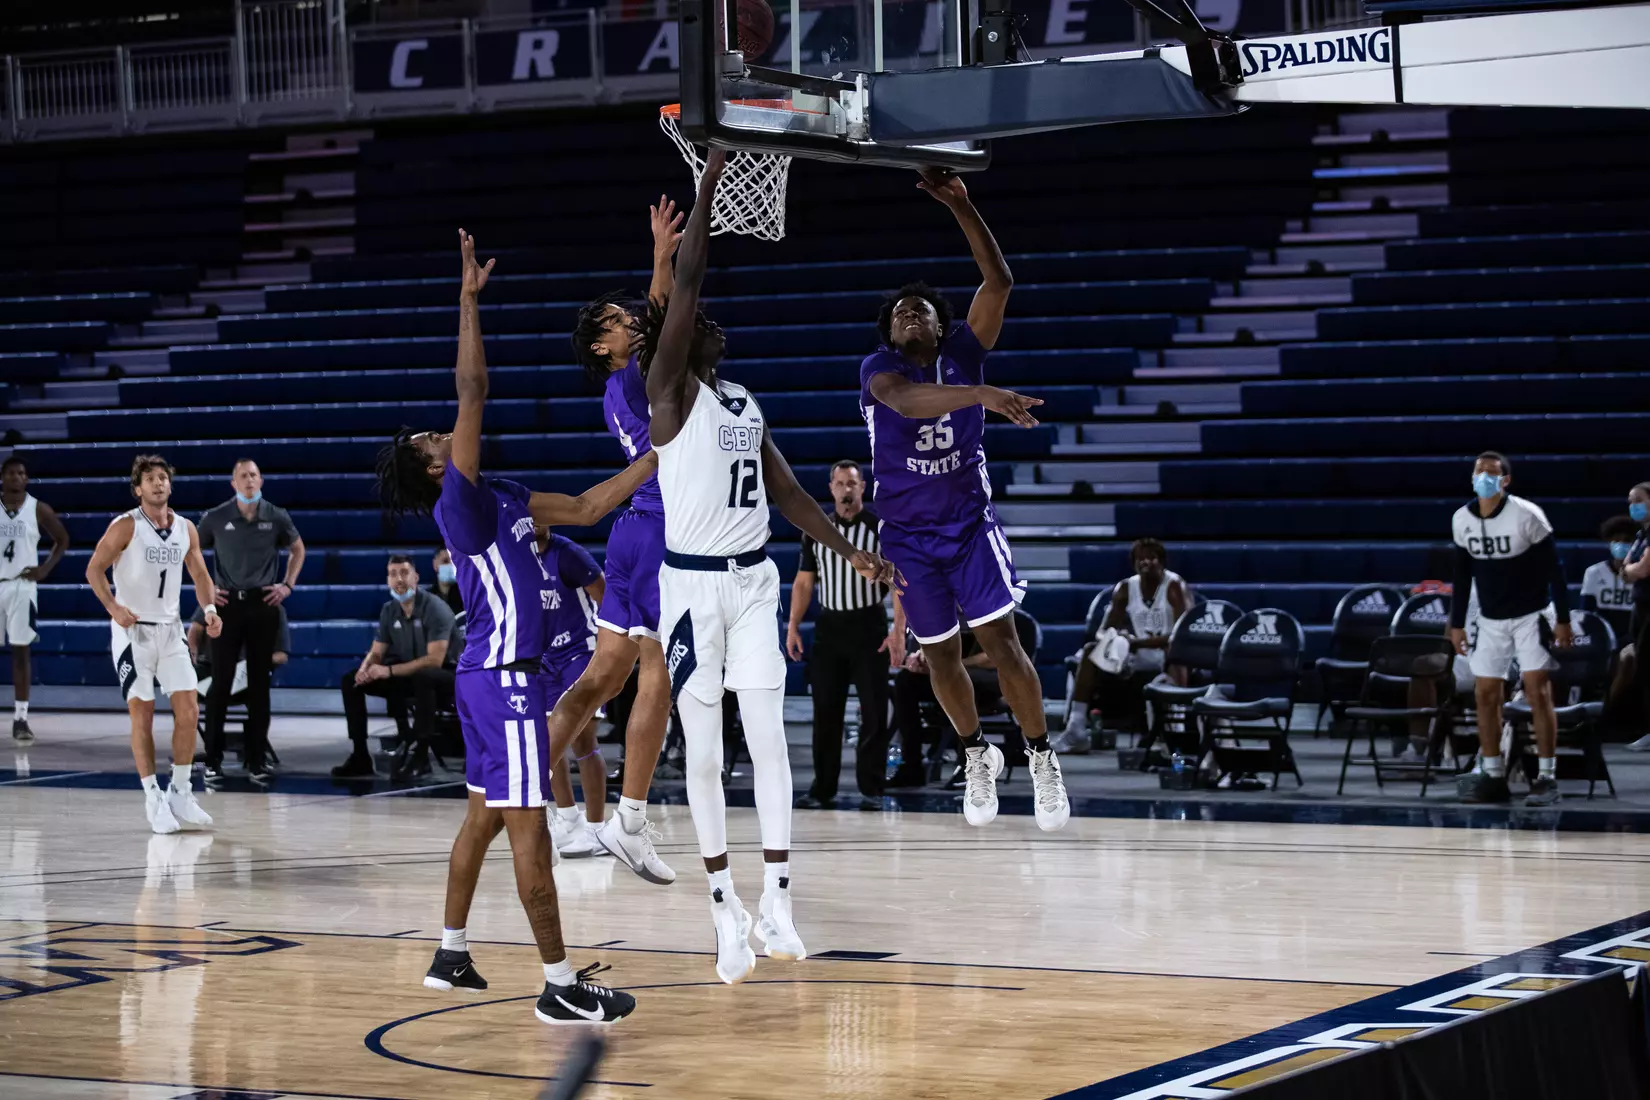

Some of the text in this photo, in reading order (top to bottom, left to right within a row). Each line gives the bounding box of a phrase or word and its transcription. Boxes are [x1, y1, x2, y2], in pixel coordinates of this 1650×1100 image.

[1242, 26, 1390, 77] SPALDING
[719, 424, 761, 453] CBU
[915, 412, 954, 452] 35
[906, 449, 961, 476] STATE
[727, 459, 759, 508] 12
[3, 540, 15, 563] 4
[145, 547, 183, 565] CBU
[1467, 535, 1512, 556] CBU
[157, 568, 168, 599] 1
[1189, 623, 1228, 633] adidas
[1240, 633, 1282, 644] adidas
